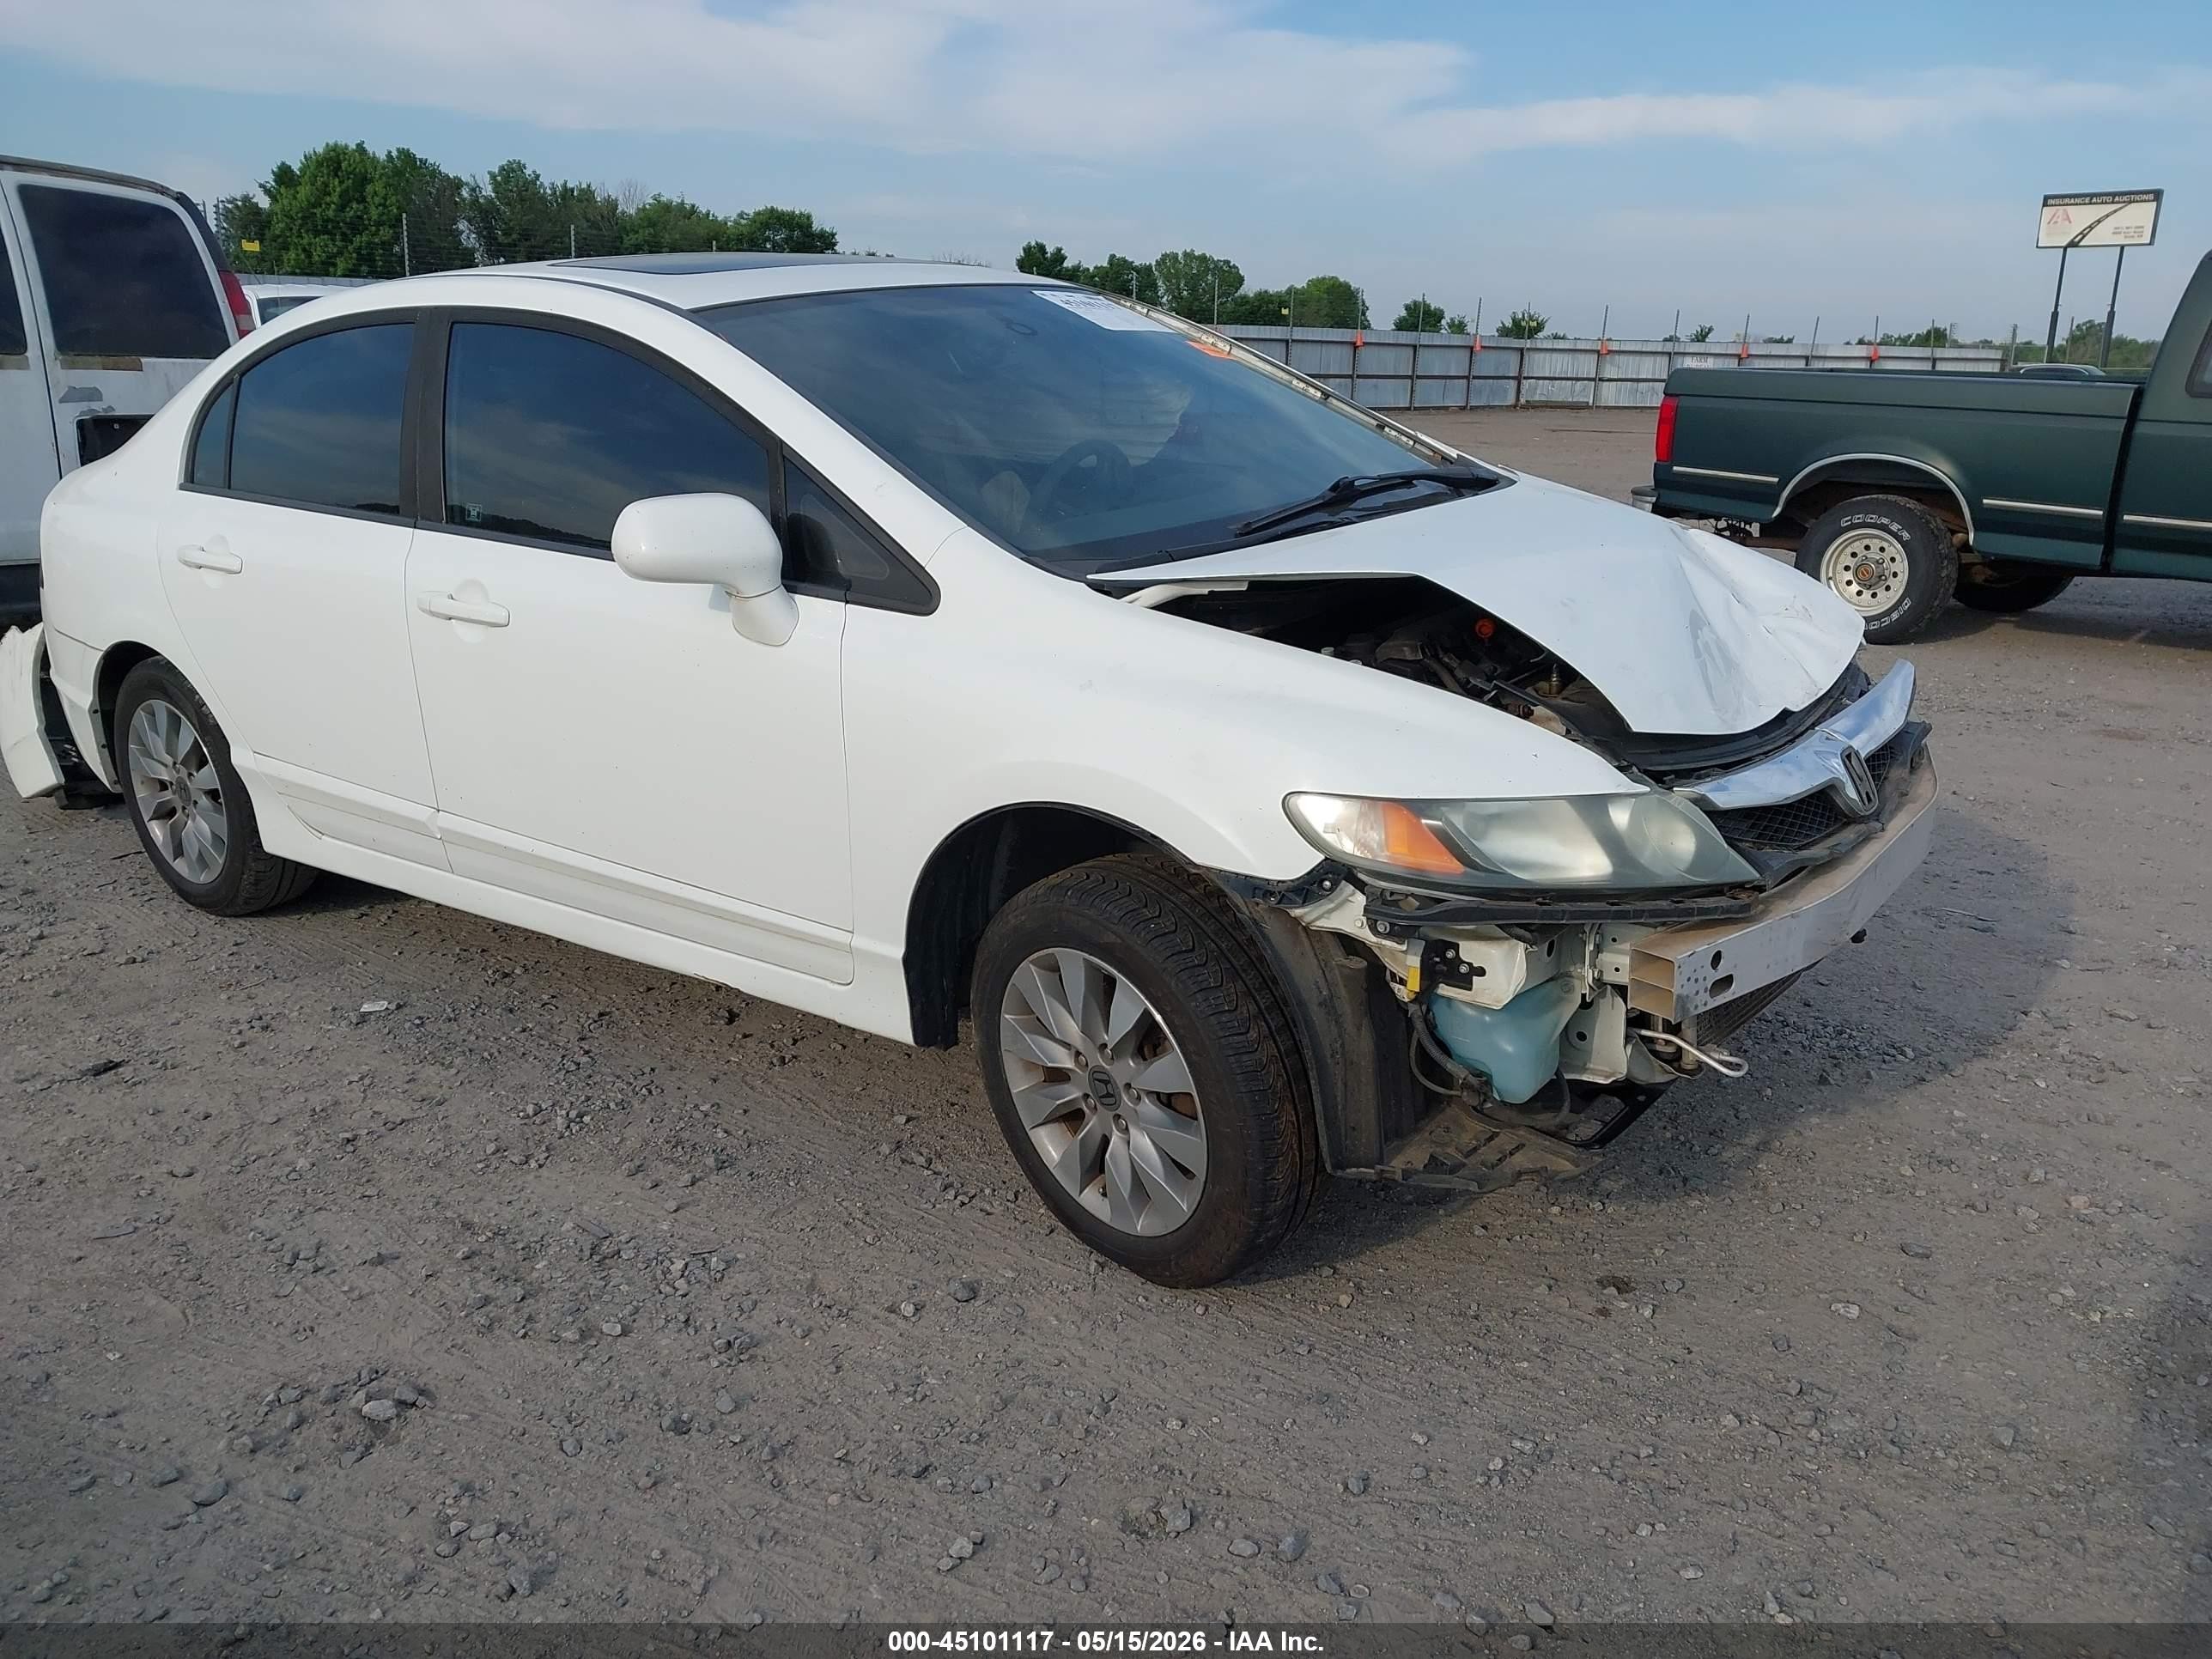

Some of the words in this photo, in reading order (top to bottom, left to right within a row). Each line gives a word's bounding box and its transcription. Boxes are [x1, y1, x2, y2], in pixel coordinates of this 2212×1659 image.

[2047, 197, 2090, 205] INSURANCE
[2113, 193, 2154, 203] AUCTIONS
[1840, 514, 1911, 541] COOPER
